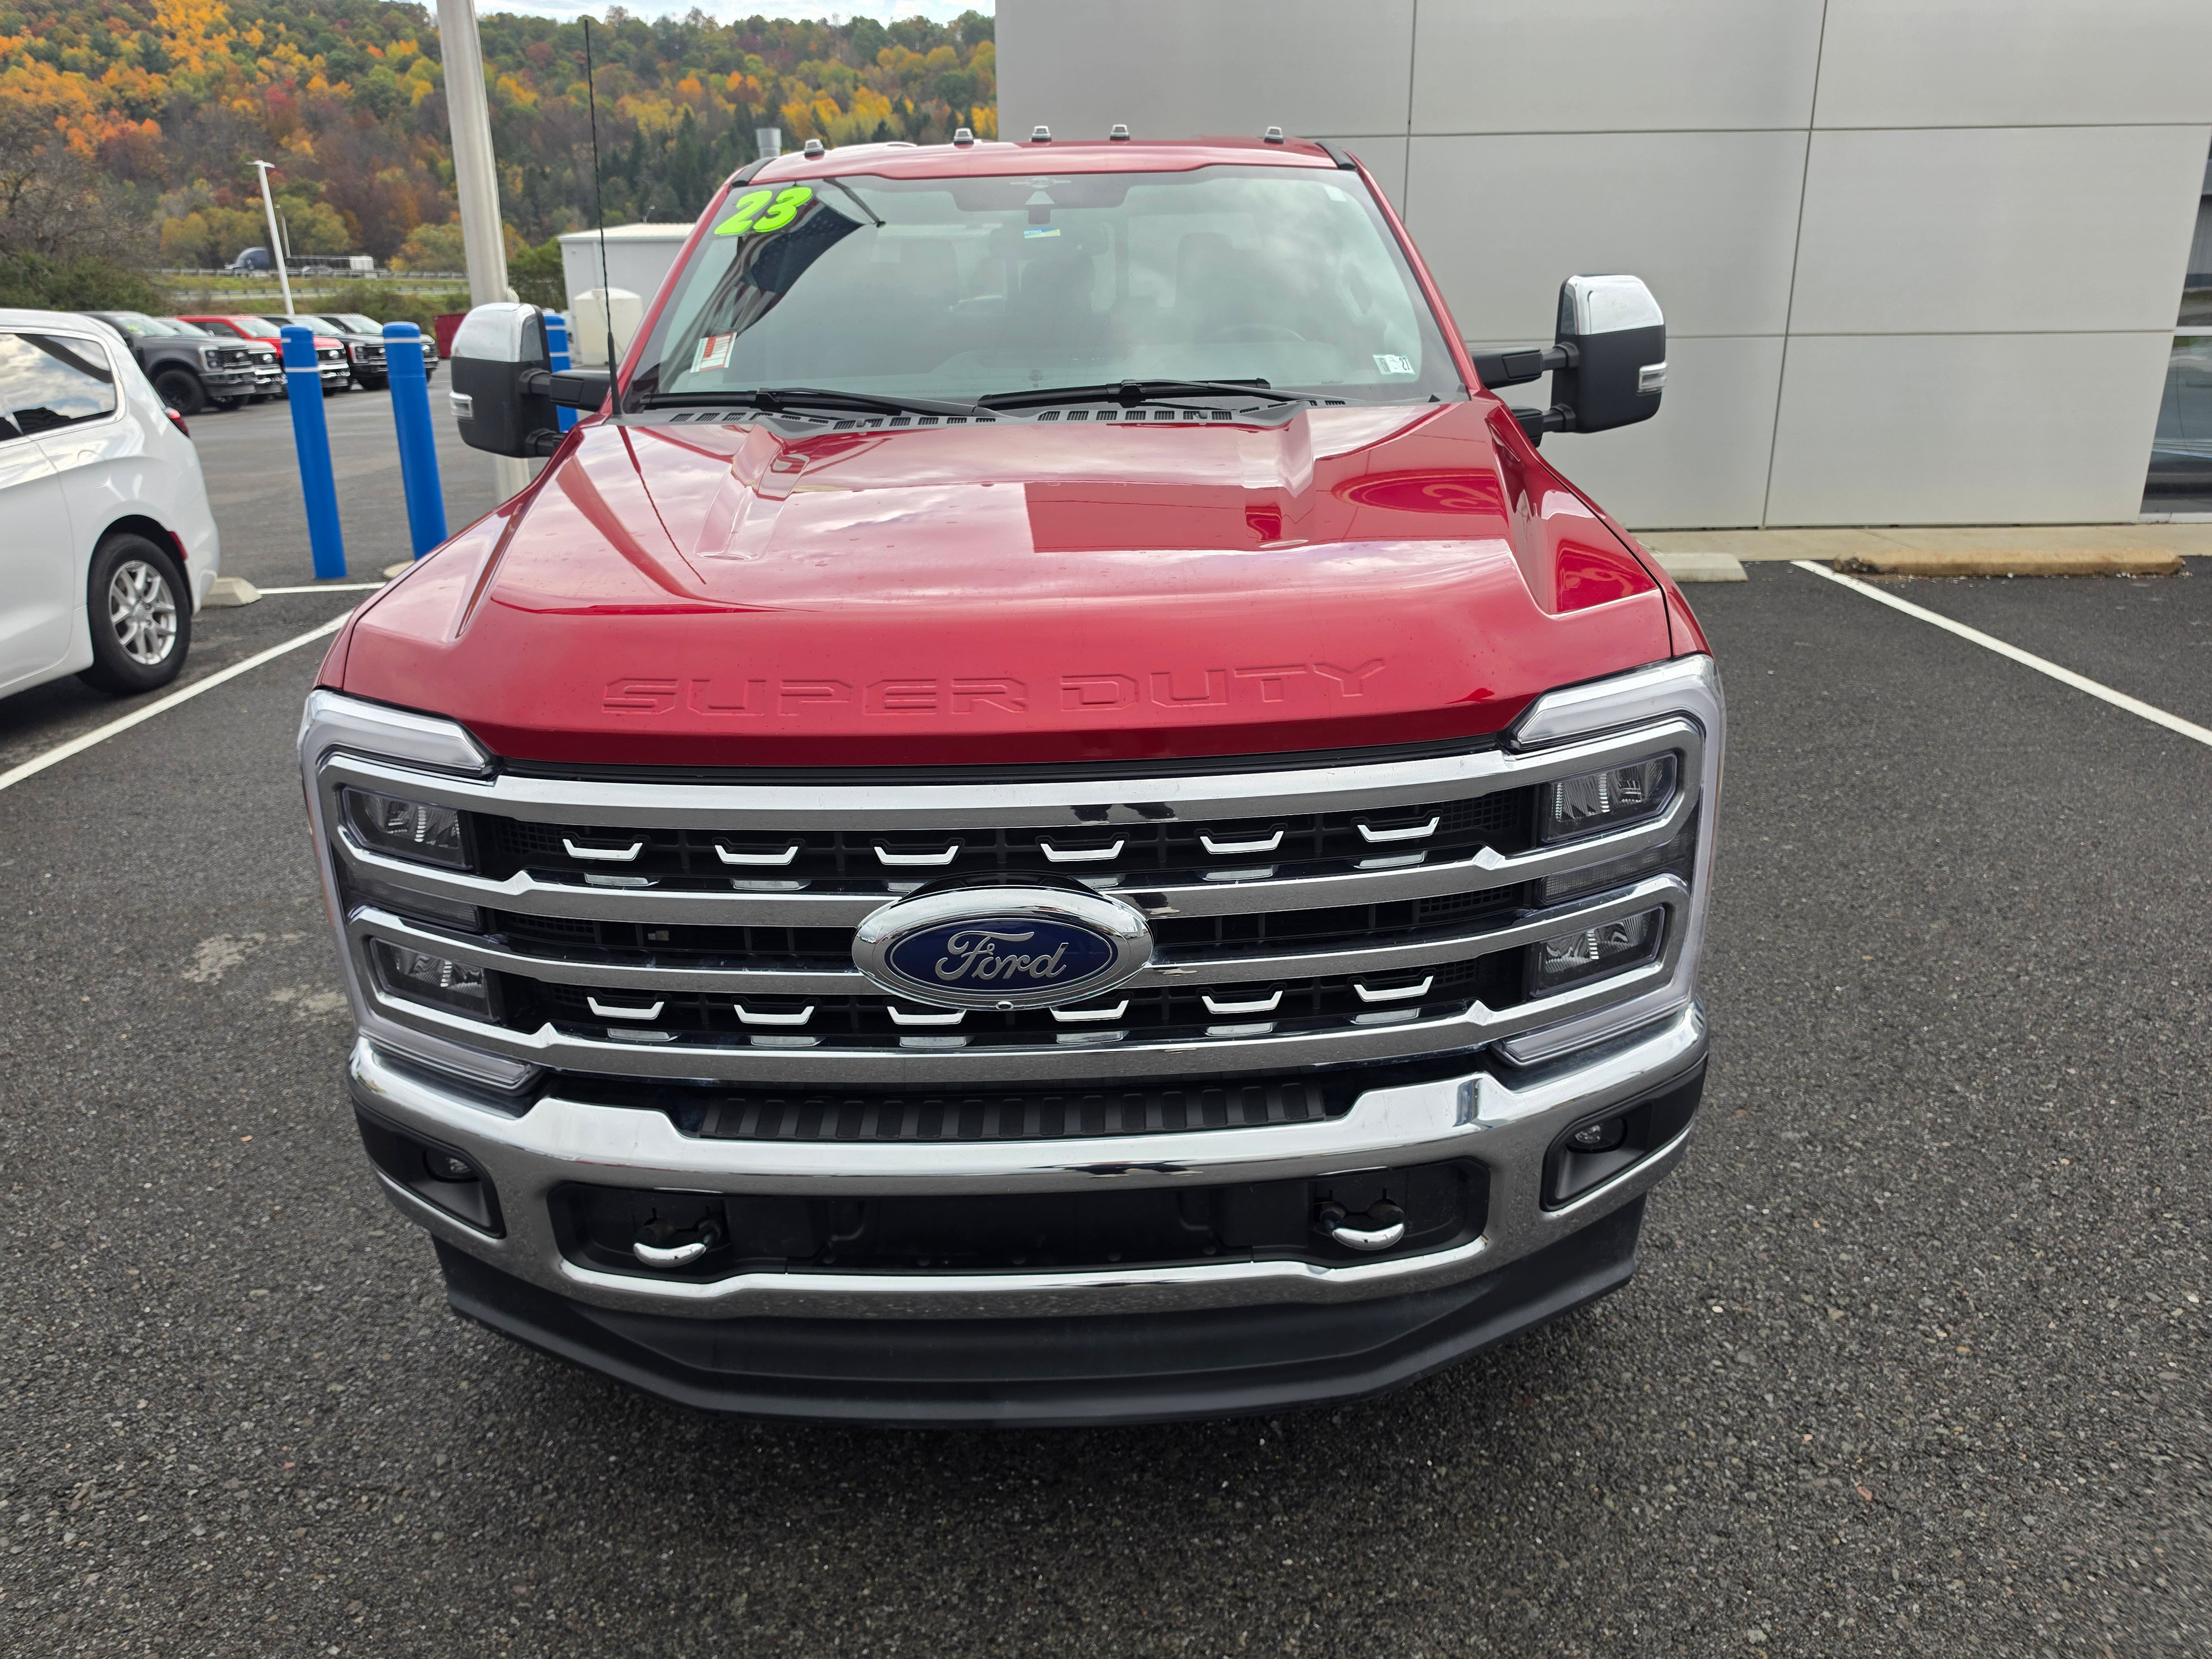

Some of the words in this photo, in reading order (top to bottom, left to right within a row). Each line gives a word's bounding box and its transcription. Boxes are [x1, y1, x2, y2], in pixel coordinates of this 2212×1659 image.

[714, 186, 813, 236] 23
[602, 677, 1027, 716] SUPER
[1060, 658, 1386, 711] DUTY
[935, 930, 1069, 980] Ford
